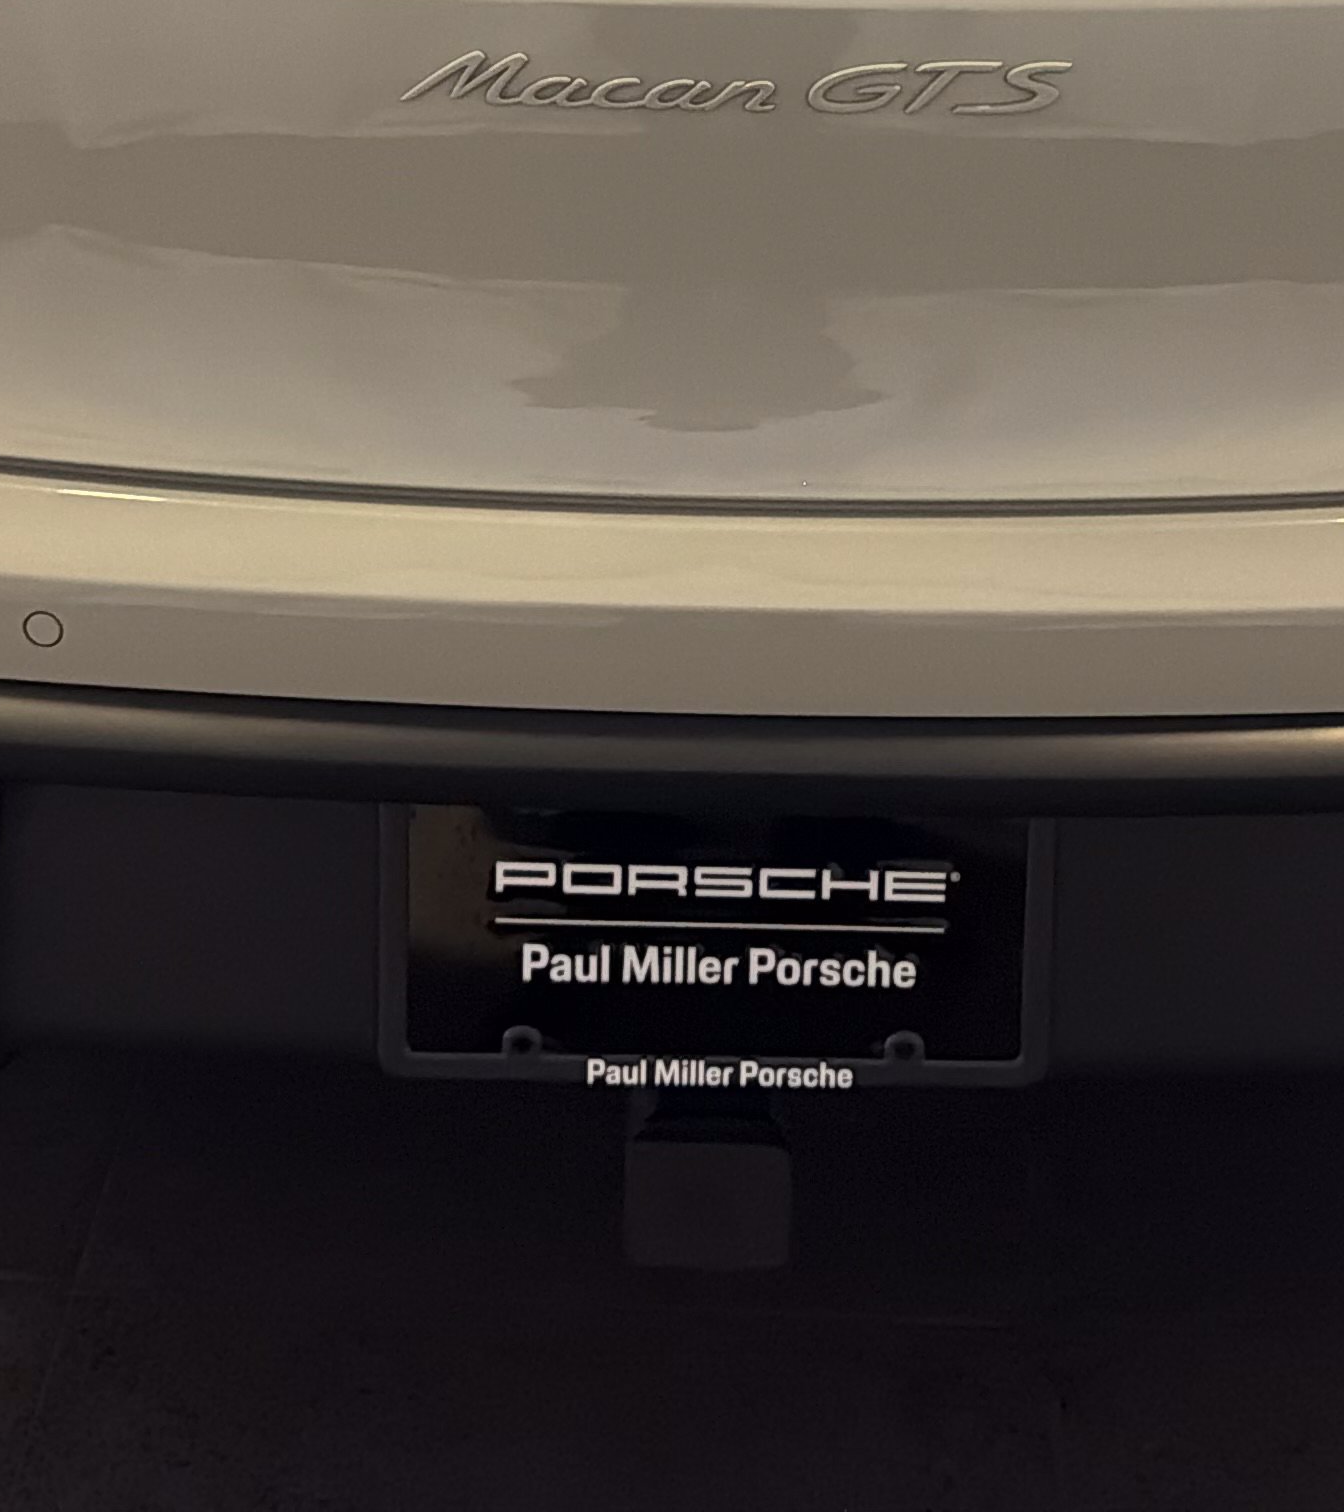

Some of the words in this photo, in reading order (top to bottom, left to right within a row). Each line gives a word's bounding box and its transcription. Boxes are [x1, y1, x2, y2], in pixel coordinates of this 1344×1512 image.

[401, 49, 778, 112] Macan
[806, 61, 1074, 116] GTS
[495, 861, 947, 903] PORSCHE
[522, 943, 611, 984] Paul
[622, 945, 740, 986] Miller
[748, 947, 917, 988] Porsche
[586, 1058, 647, 1086] Paul
[654, 1059, 734, 1087] Miller
[739, 1060, 854, 1089] Porsche
